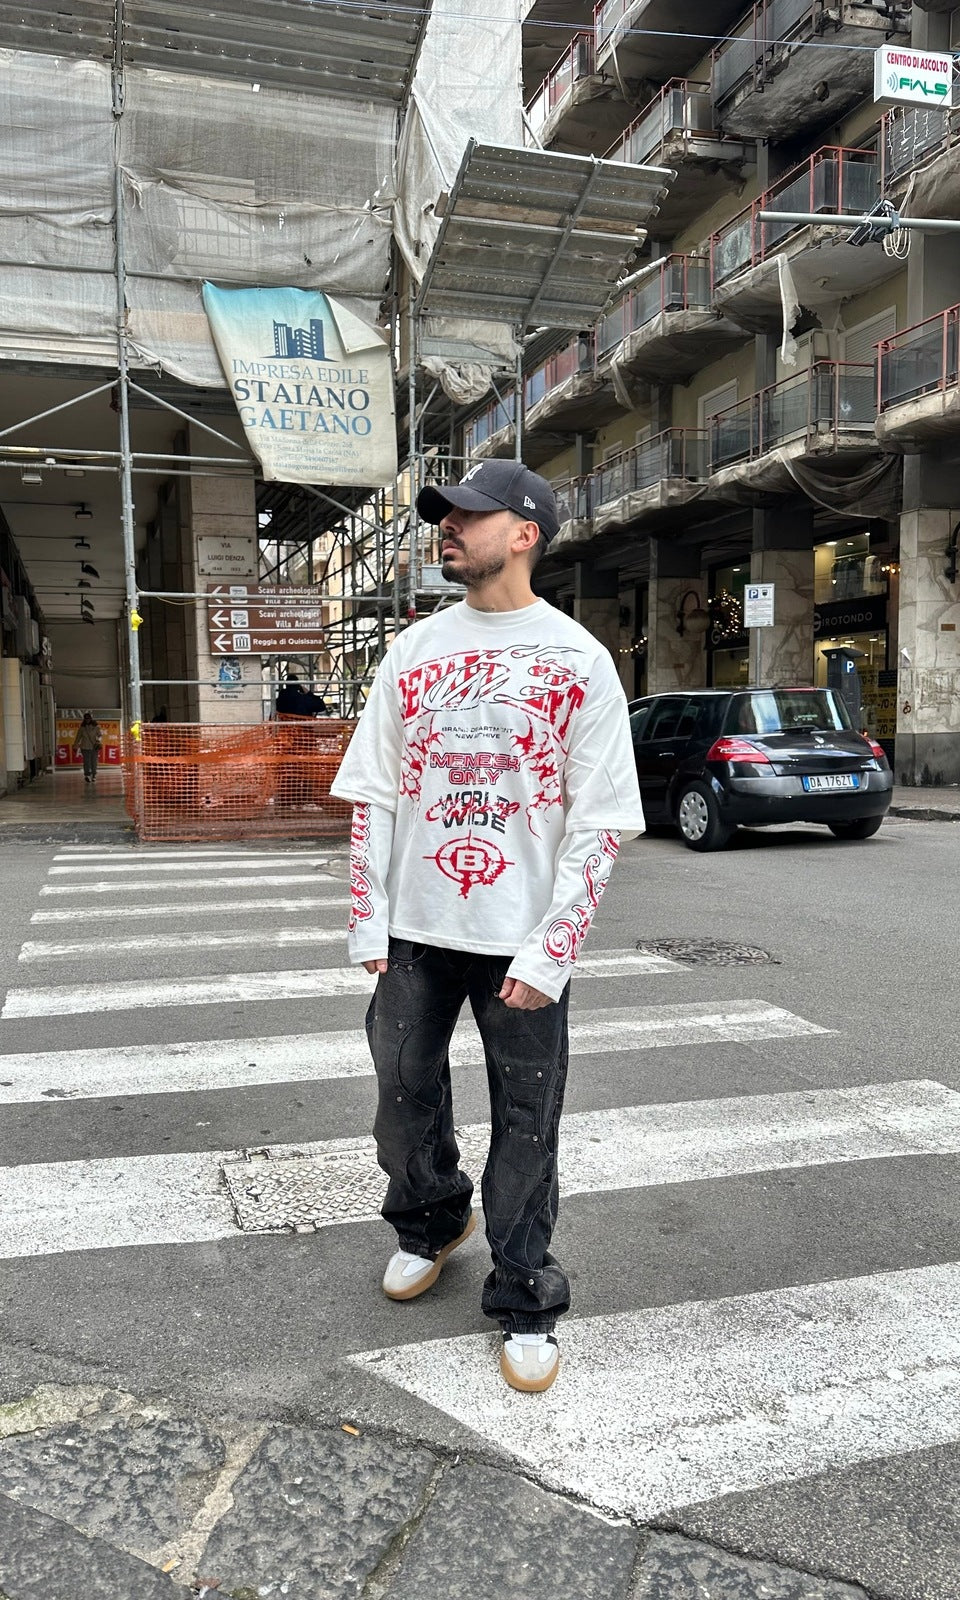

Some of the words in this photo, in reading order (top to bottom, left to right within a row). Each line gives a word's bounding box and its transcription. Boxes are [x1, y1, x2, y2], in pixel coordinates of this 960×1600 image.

[887, 52, 911, 67] CENTRO
[912, 56, 919, 68] DI
[920, 58, 948, 73] ASCOLTO
[232, 359, 313, 380] IMPRESA
[317, 366, 369, 384] EDILE
[234, 379, 369, 410] STAIANO
[240, 406, 371, 436] GAETANO
[258, 586, 276, 594] Scavi
[279, 586, 319, 596] archeologici
[259, 610, 277, 618] Scavi
[280, 610, 319, 619] archeologici
[275, 620, 292, 628] Villa
[295, 620, 320, 628] Arianna
[813, 611, 873, 632] GIROTONDO
[253, 638, 277, 647] Reggia
[846, 661, 854, 673] P
[430, 752, 521, 772] MEMBER
[449, 768, 503, 786] ONLY
[810, 776, 822, 788] DA
[826, 774, 852, 787] 176ZT
[442, 812, 506, 834] WIDE
[456, 849, 488, 872] B
